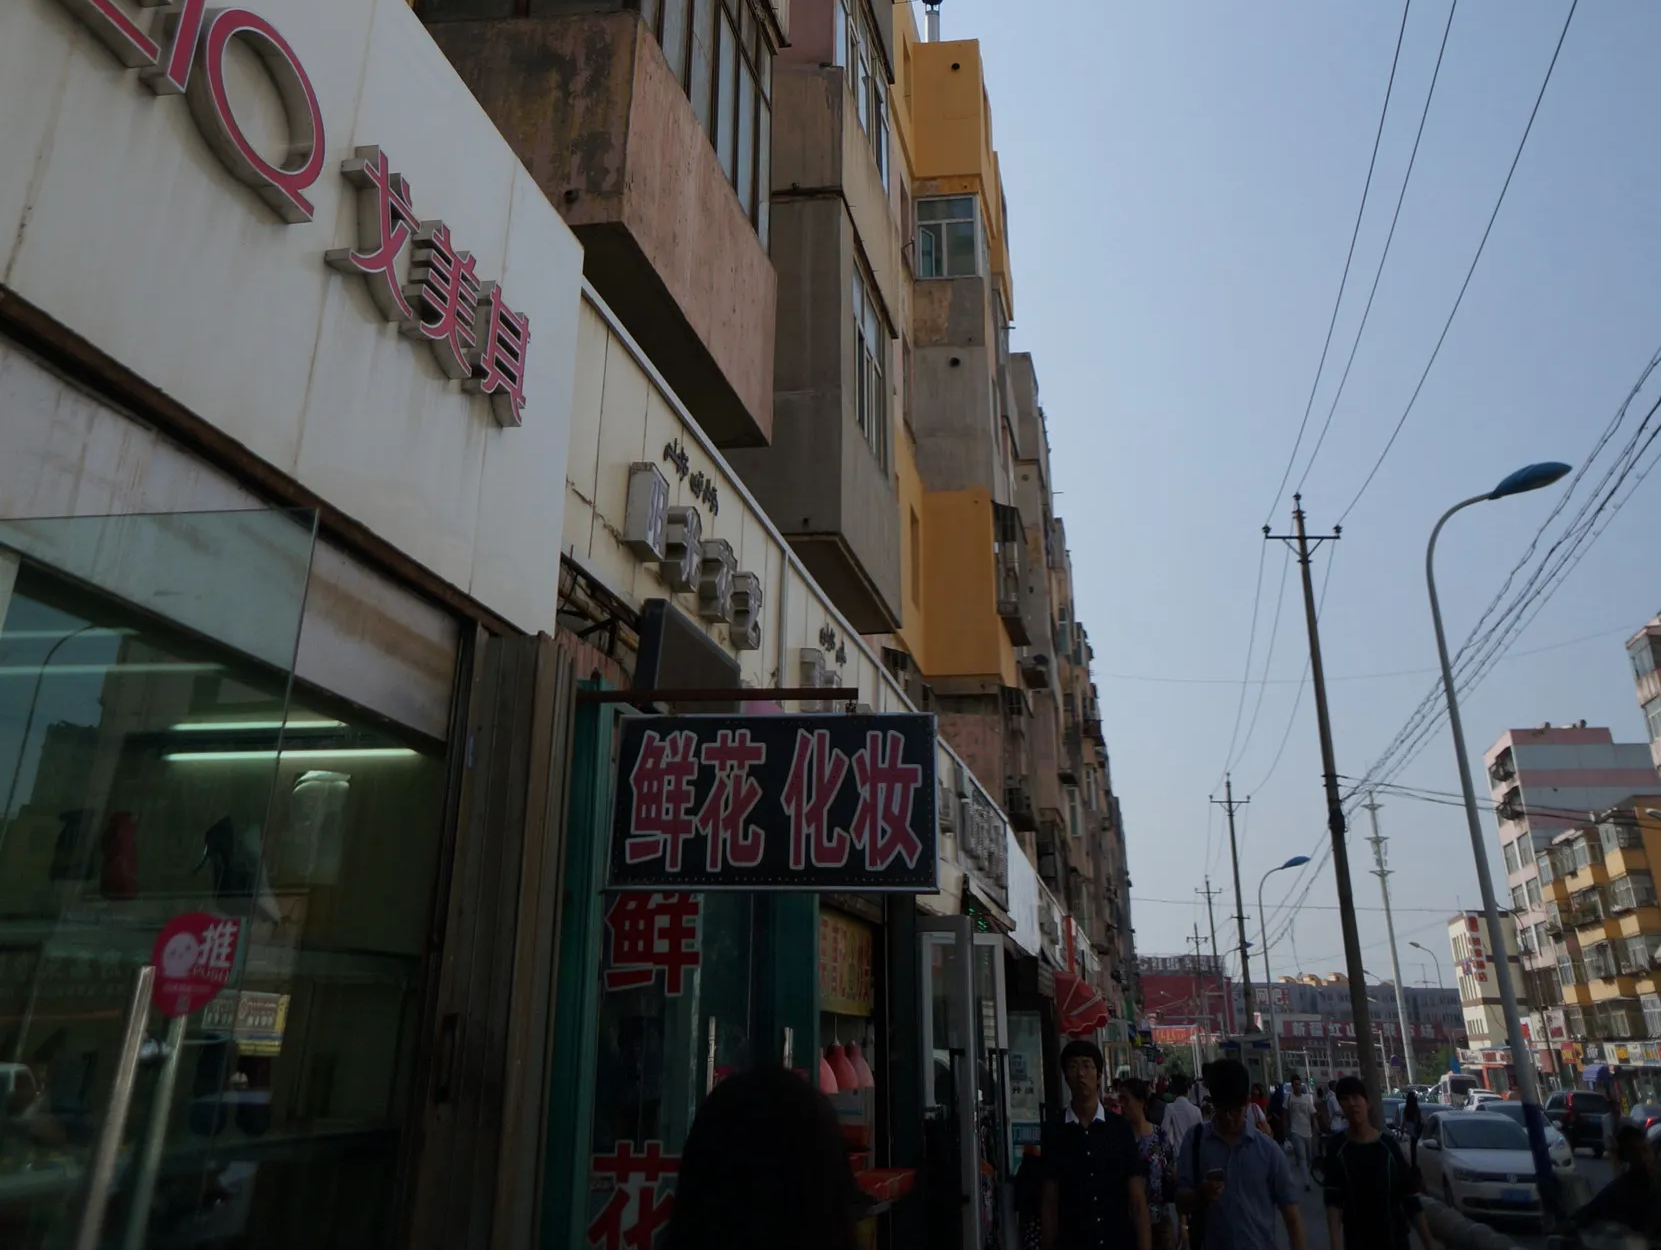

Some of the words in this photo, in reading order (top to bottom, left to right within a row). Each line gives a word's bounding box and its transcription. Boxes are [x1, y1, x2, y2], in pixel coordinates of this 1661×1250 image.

[625, 728, 767, 873] 鲜花
[780, 728, 923, 872] 化妆
[192, 964, 232, 983] PUSH
[196, 921, 239, 968] 推
[603, 893, 703, 997] 鲜
[588, 1139, 683, 1250] 花
